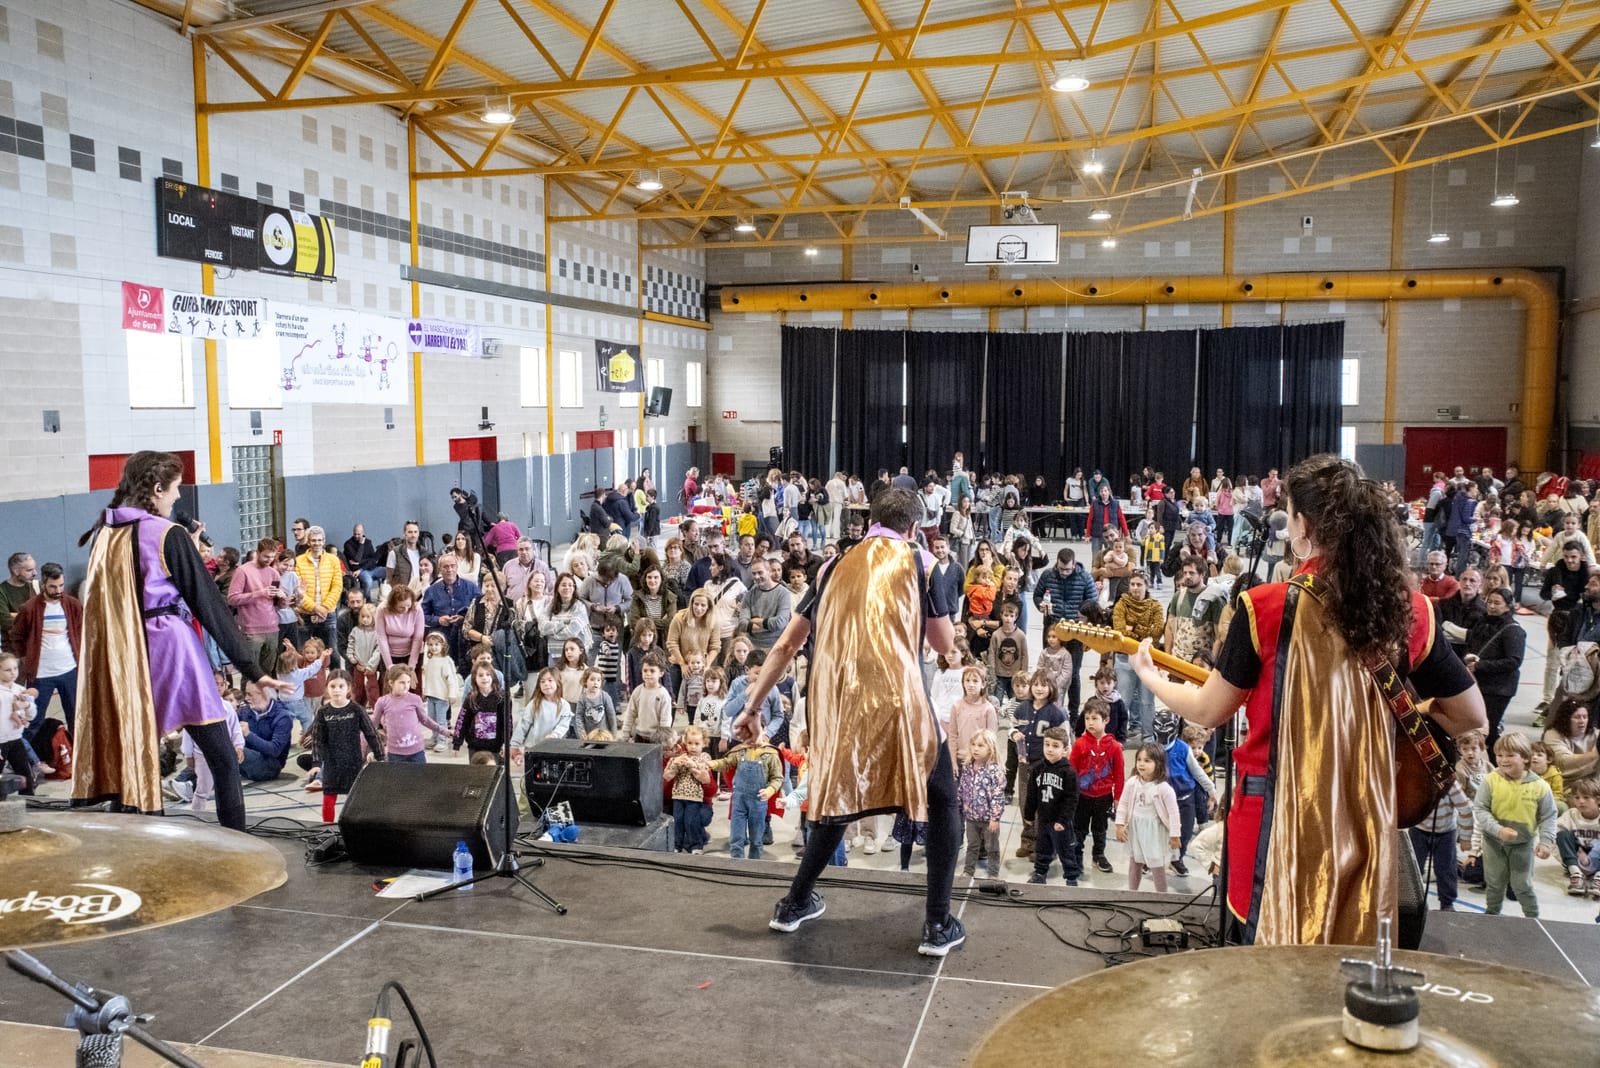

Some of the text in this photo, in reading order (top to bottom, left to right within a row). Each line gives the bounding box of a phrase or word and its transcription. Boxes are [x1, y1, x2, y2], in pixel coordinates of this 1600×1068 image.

[168, 212, 196, 228] LOCAL
[230, 225, 255, 239] VISITANT
[172, 294, 199, 313] GURB
[132, 319, 158, 331] de Gurb
[0, 891, 117, 914] Bosp
